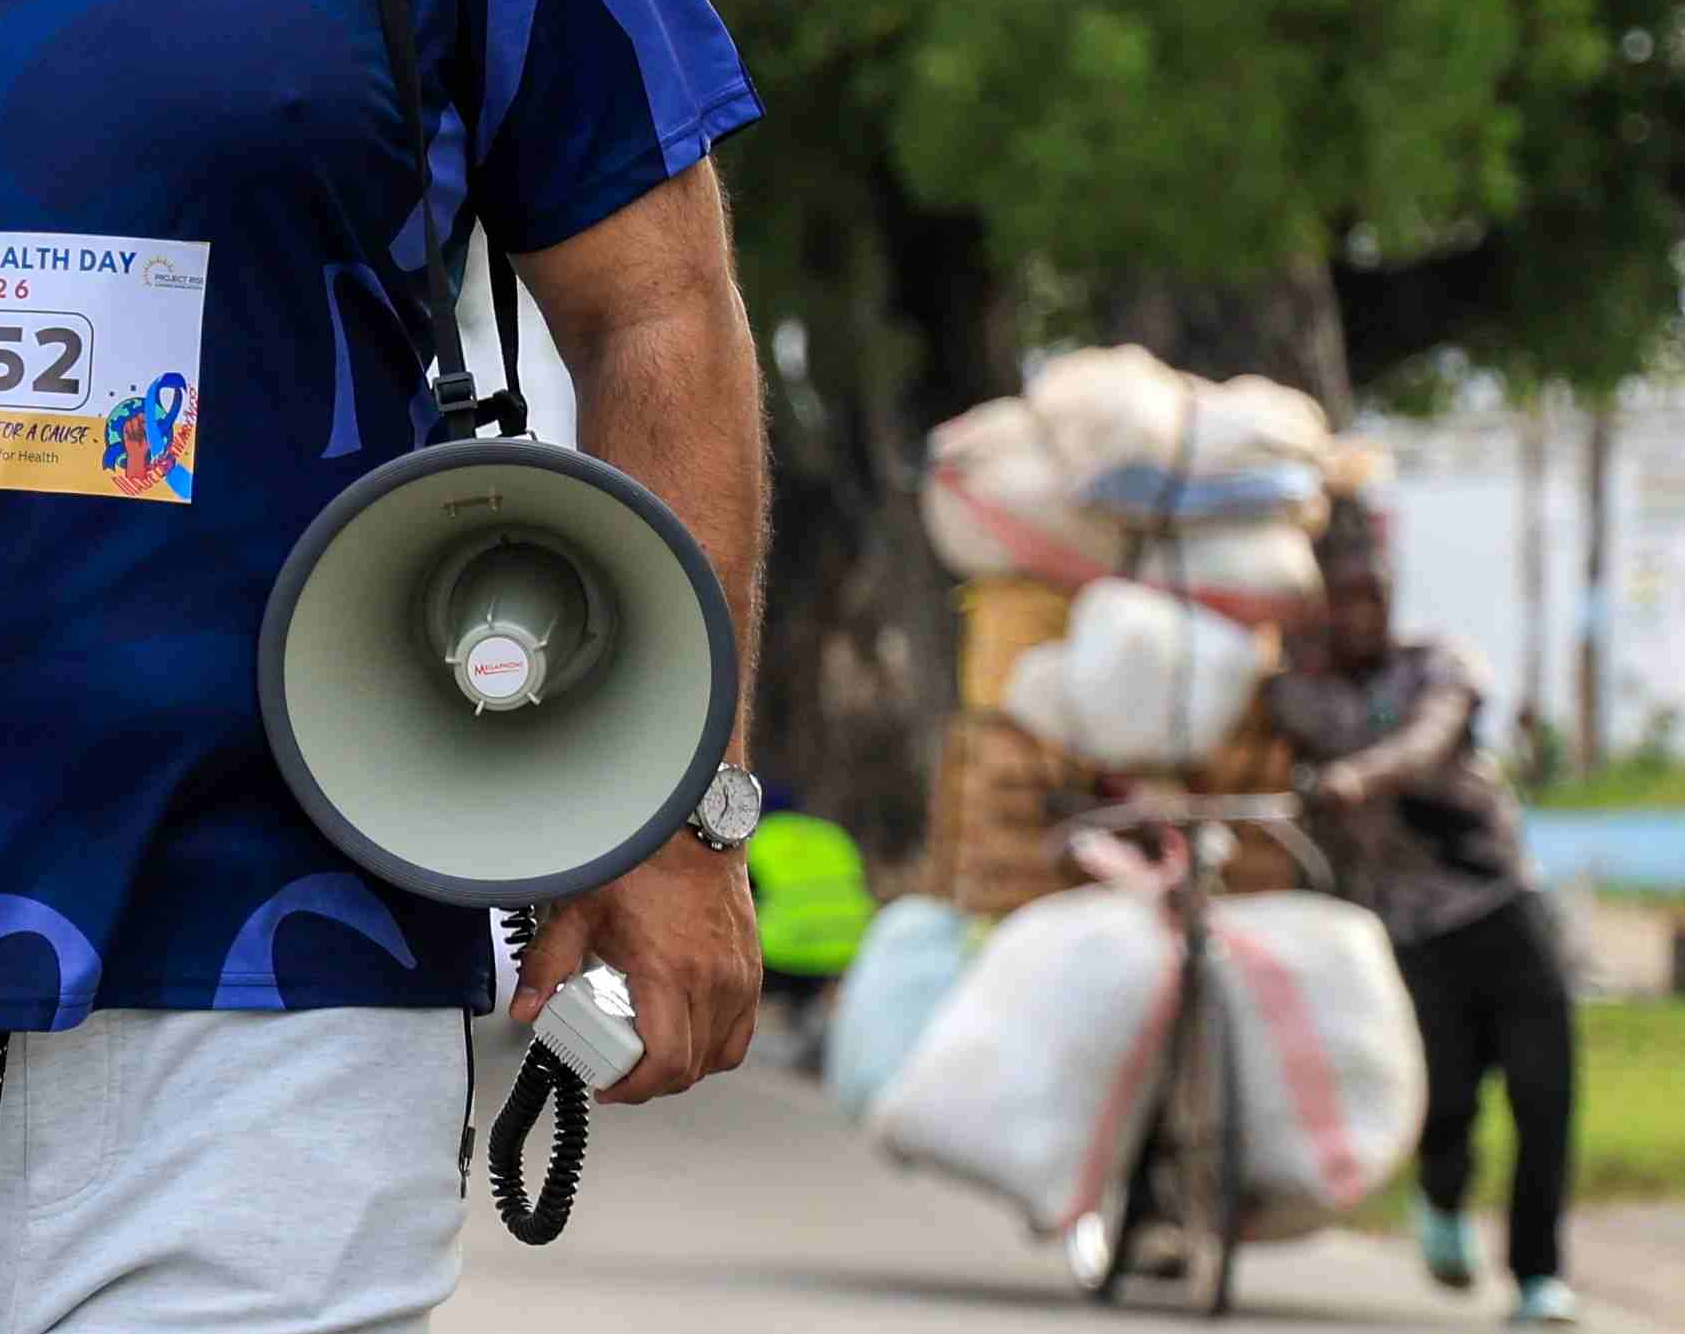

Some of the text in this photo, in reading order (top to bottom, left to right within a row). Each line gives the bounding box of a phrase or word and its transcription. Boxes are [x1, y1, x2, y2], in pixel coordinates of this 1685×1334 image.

[78, 249, 138, 274] DAY
[26, 422, 38, 440] A
[17, 450, 60, 464] Health
